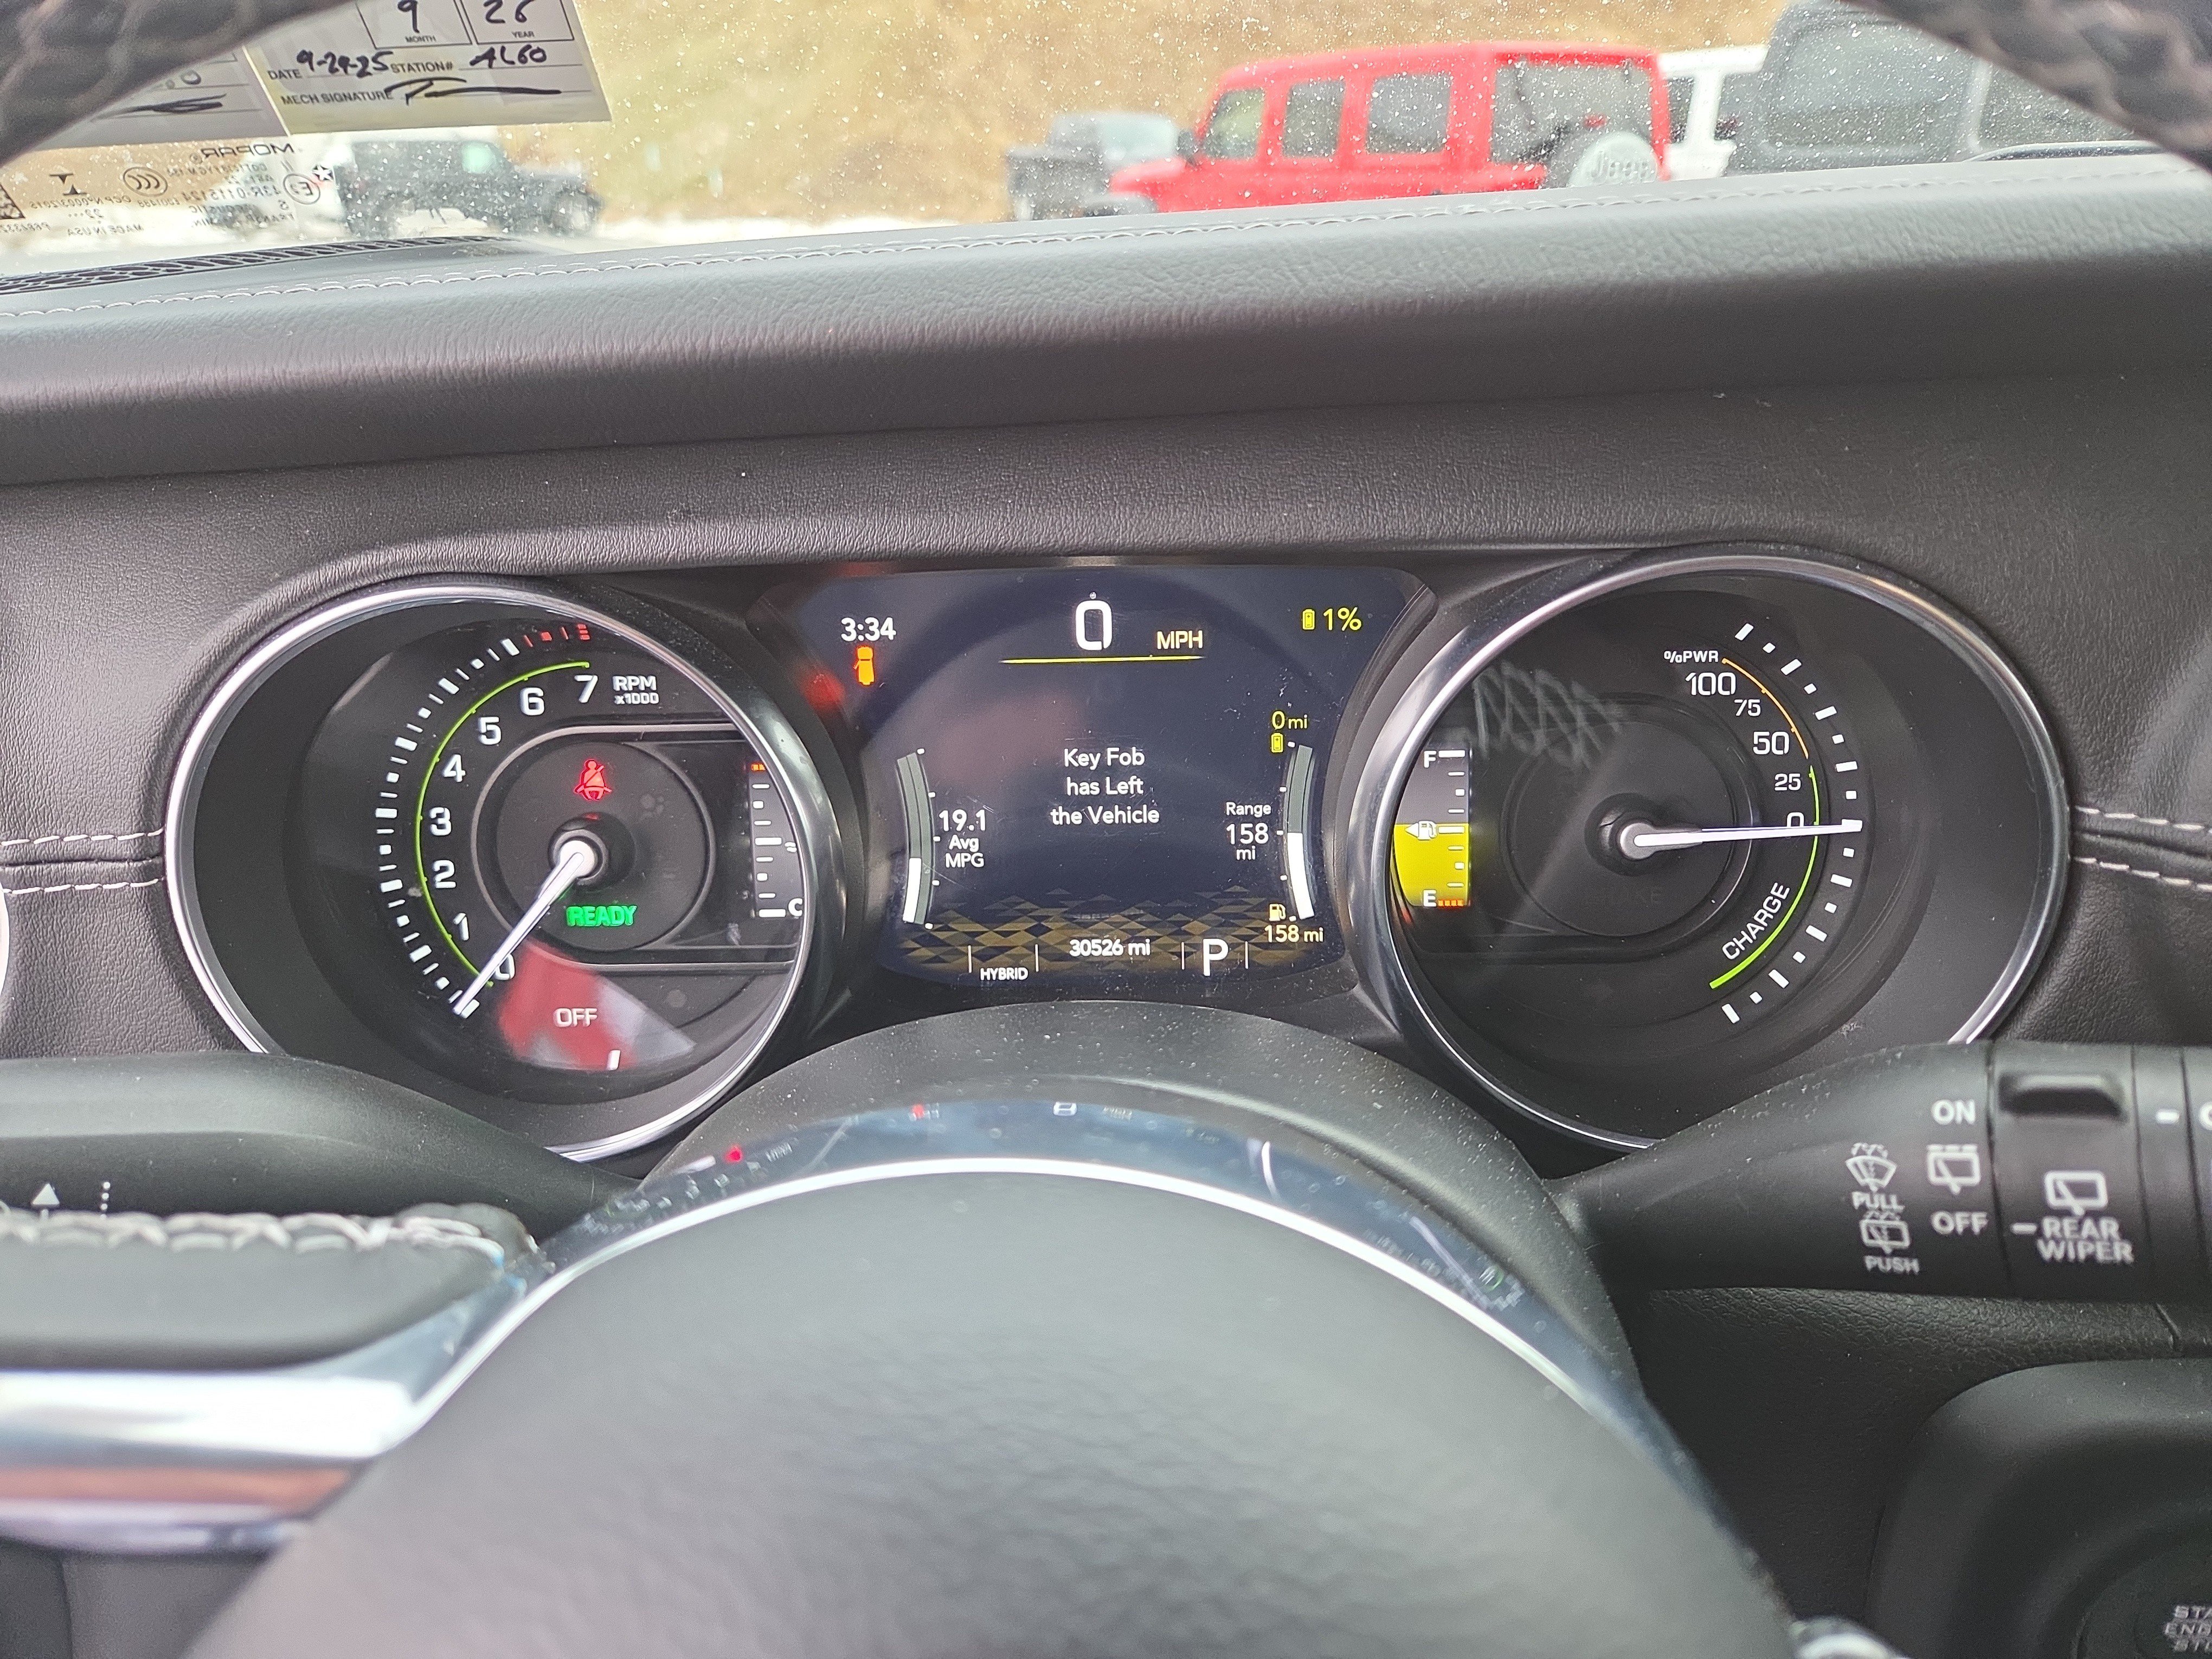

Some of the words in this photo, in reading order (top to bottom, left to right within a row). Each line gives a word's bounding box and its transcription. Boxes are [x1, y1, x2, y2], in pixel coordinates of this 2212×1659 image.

[398, 0, 420, 33] 9
[483, 0, 535, 23] 26
[267, 69, 303, 80] DATE
[390, 61, 453, 74] STATION#
[281, 93, 320, 105] MECH
[321, 91, 394, 103] SIGNATURE
[841, 617, 897, 642] 3:34
[1076, 600, 1113, 651] 0
[1323, 607, 1362, 631] 1%
[1156, 630, 1203, 650] MPH
[1664, 650, 1719, 663] %PWR
[574, 674, 599, 704] 7
[613, 675, 657, 692] RPM
[1685, 672, 1736, 696] 100
[519, 686, 545, 716] 6
[614, 692, 659, 705] x1000
[1734, 699, 1761, 716] 75
[478, 716, 501, 745] 5
[1272, 711, 1285, 730] 0
[1288, 714, 1308, 729] mi
[1753, 731, 1789, 755] 50
[442, 755, 466, 782] 4
[1064, 748, 1101, 770] Key
[1107, 747, 1145, 766] Fob
[1424, 750, 1437, 768] F
[1067, 776, 1099, 795] has
[1105, 775, 1144, 795] Left
[1774, 773, 1801, 791] 25
[938, 809, 986, 832] 19.1
[1051, 806, 1082, 825] the
[1088, 805, 1160, 824] Vehicle
[1226, 802, 1271, 818] Range
[429, 807, 452, 836] 3
[949, 834, 979, 851] Avg
[1226, 822, 1269, 845] 158
[945, 853, 985, 868] MPG
[1236, 846, 1256, 860] mi
[433, 860, 456, 889] 2
[1423, 889, 1437, 907] E
[453, 913, 470, 941] 1
[567, 905, 637, 927] READY
[1721, 882, 1790, 960] CHARGE
[1265, 924, 1299, 943] 158
[1304, 927, 1324, 943] mi
[1070, 940, 1123, 957] 30526
[1128, 938, 1150, 956] mi
[1203, 938, 1229, 976] P
[980, 967, 1028, 980] HYBRID
[554, 1007, 597, 1027] OFF
[1931, 1099, 1975, 1125] ON
[1853, 1191, 1905, 1212] PULL
[1931, 1211, 1988, 1236] OFF
[2041, 1216, 2120, 1240] REAR
[2036, 1238, 2134, 1265] WIPER
[1863, 1255, 1920, 1275] PUSH
